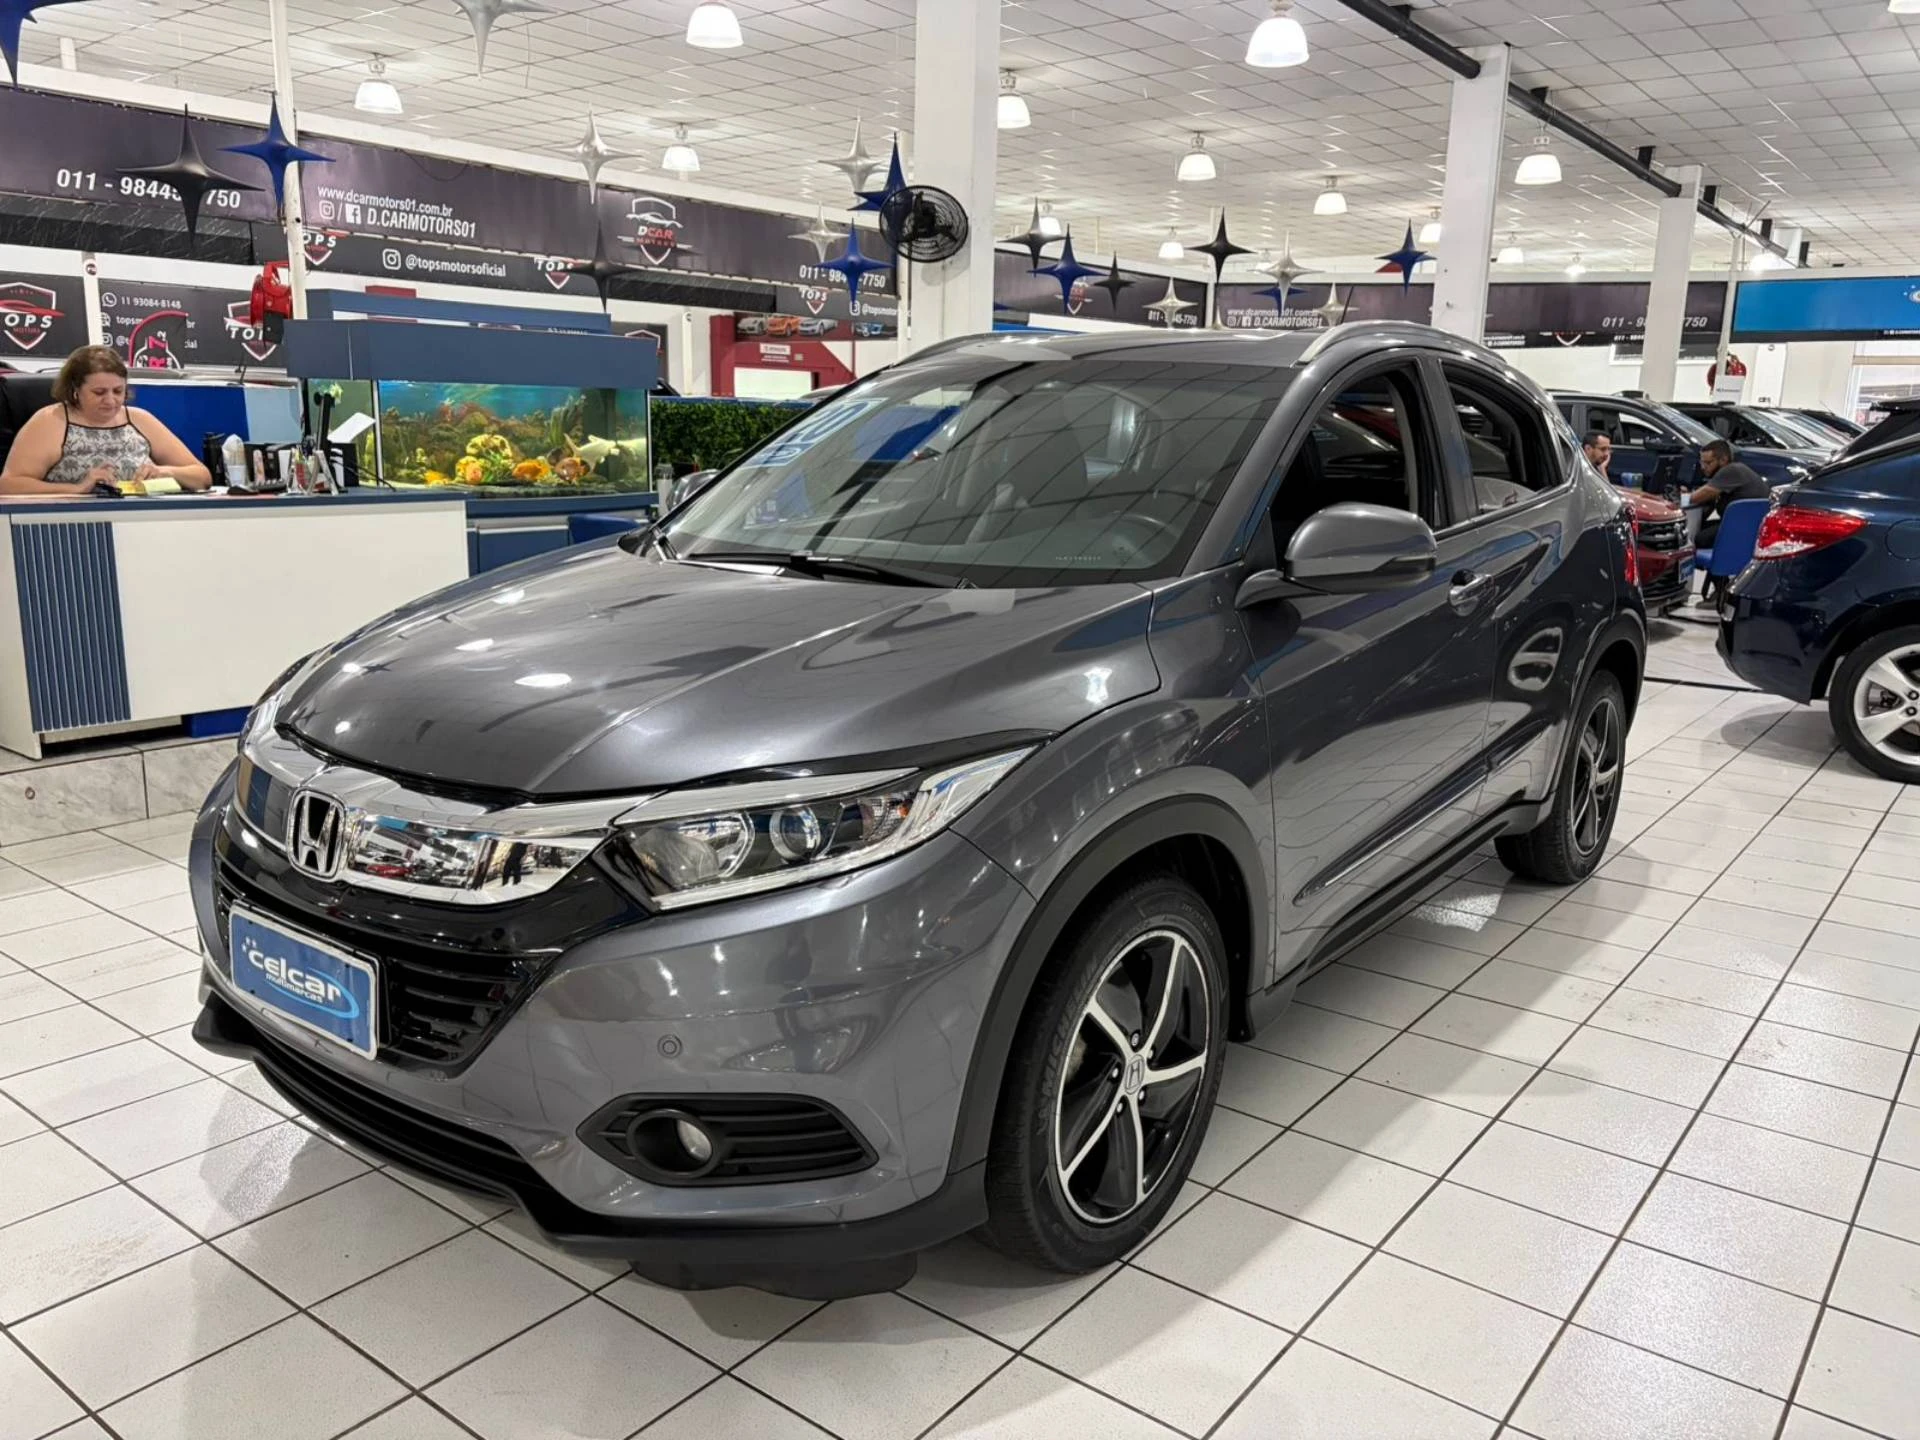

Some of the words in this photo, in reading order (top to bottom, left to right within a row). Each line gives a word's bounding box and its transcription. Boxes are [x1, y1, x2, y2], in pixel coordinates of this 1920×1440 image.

[56, 168, 96, 191] 011
[317, 185, 454, 217] www.dcarmotors01.com.br
[366, 207, 477, 239] D.CARMOTORS01
[637, 225, 674, 240] DCAR
[405, 253, 507, 277] @topsmotorsoficial
[799, 264, 818, 279] 011
[828, 268, 886, 288] 984-7750
[121, 296, 131, 305] 11
[801, 288, 827, 301] TOPS
[4, 313, 53, 329] OPS
[1602, 316, 1624, 328] 011
[249, 949, 342, 1001] celcar
[265, 973, 323, 1004] multimarcas
